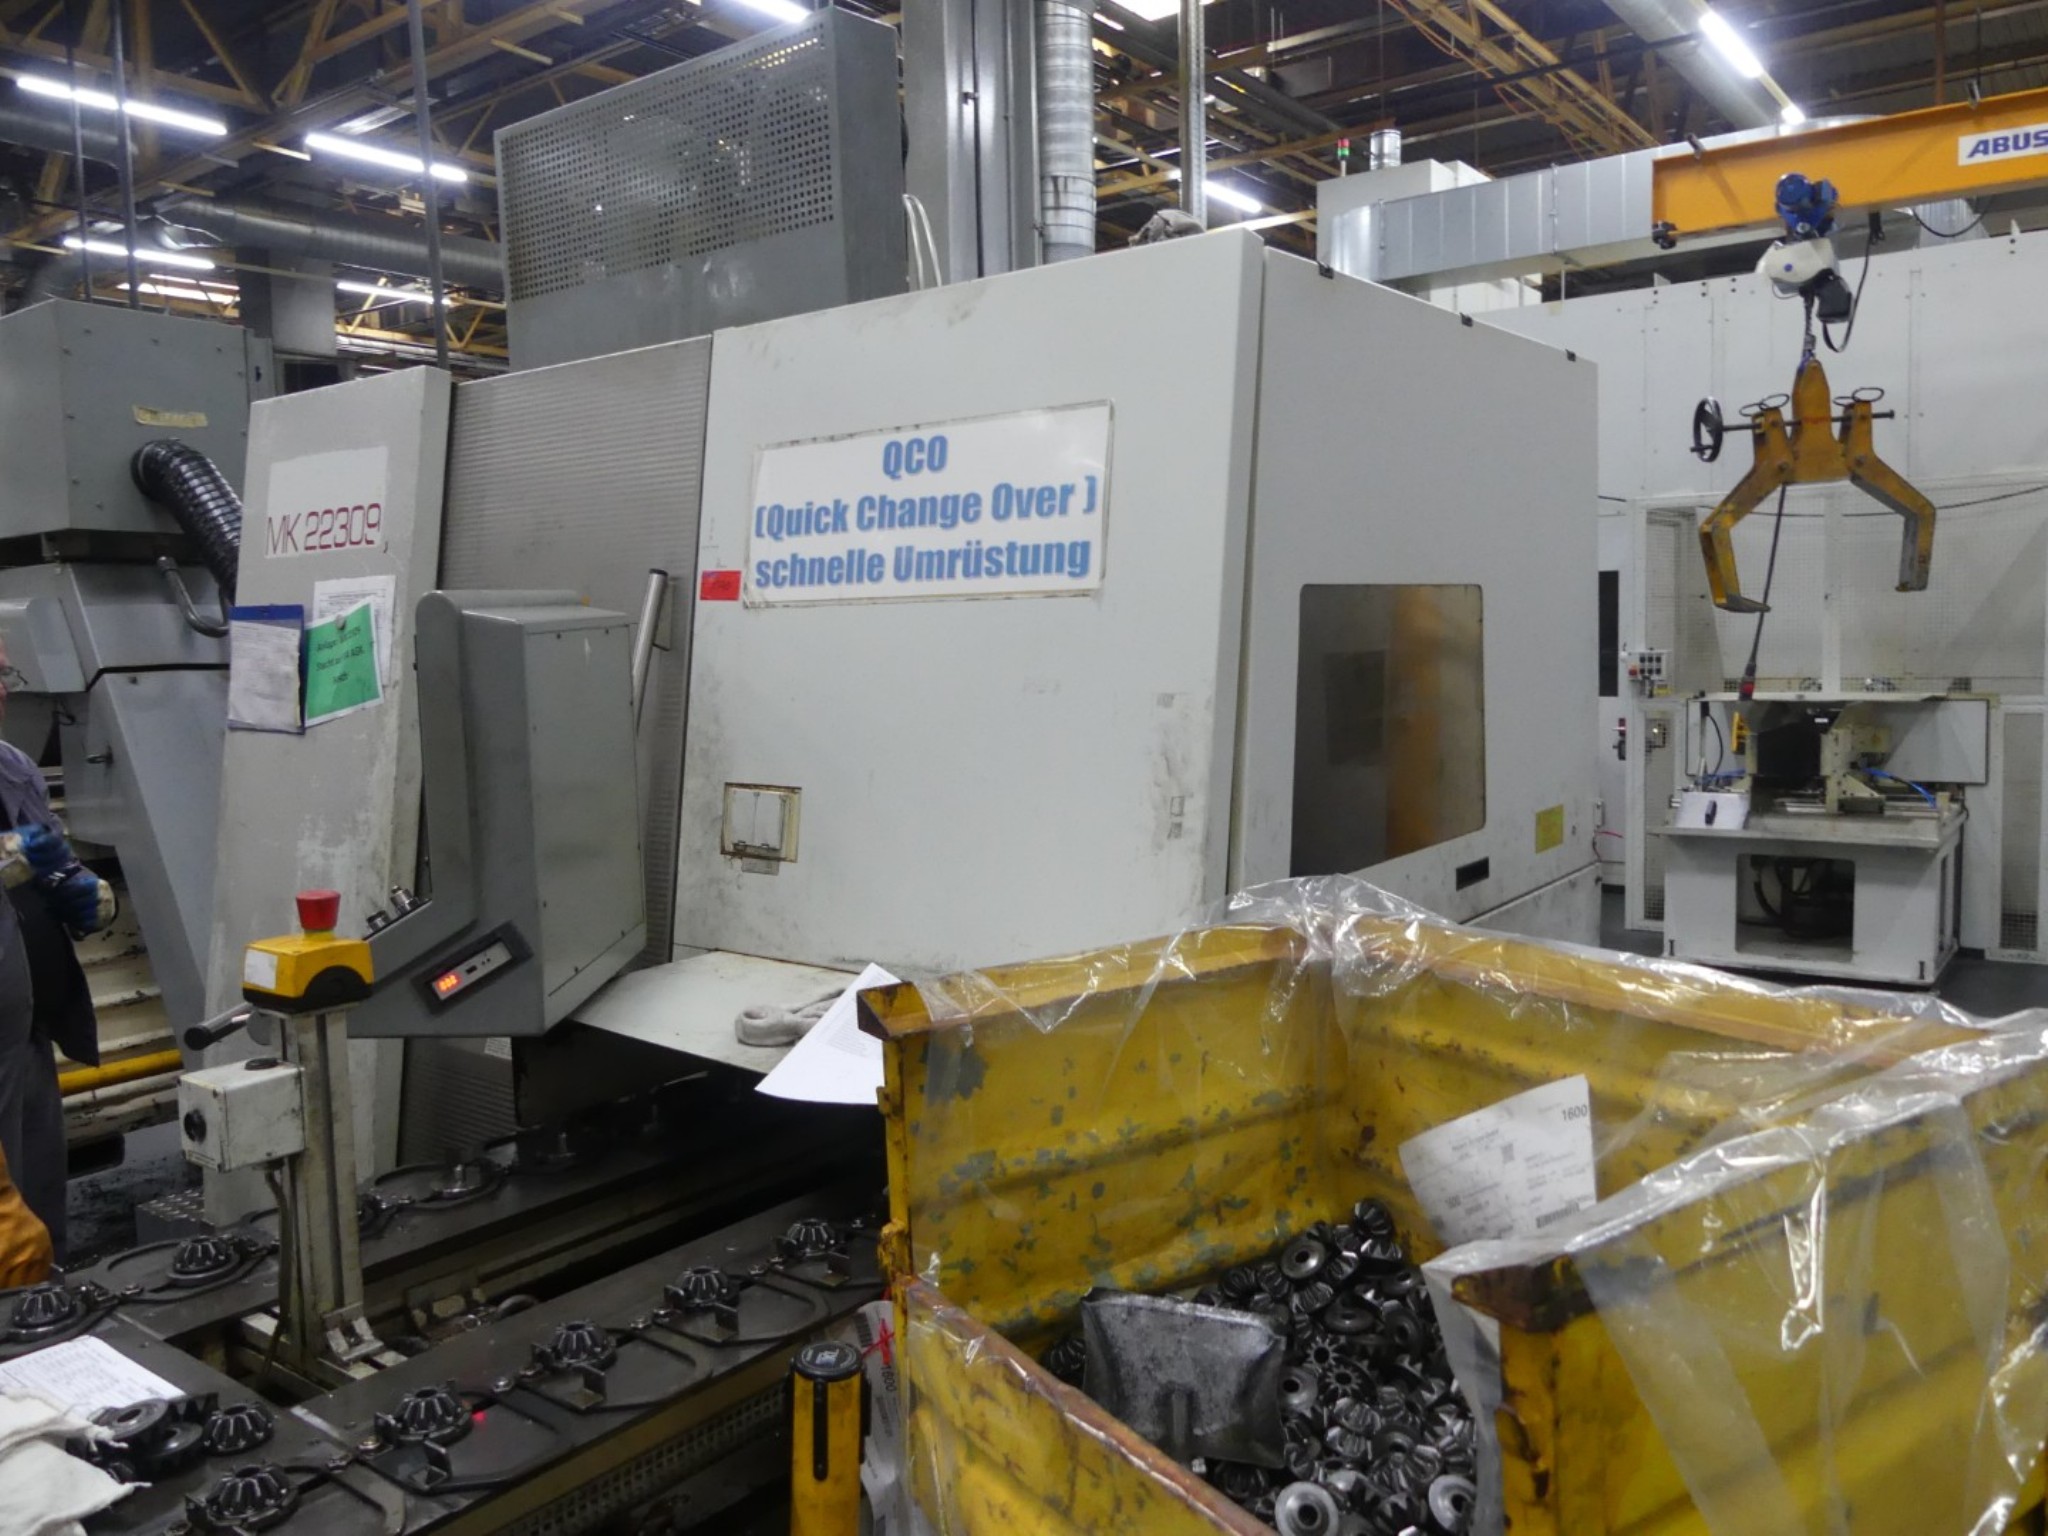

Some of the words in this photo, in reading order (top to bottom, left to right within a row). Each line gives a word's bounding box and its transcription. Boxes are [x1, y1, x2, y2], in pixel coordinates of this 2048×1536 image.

[1966, 130, 2048, 159] ABUS
[883, 435, 948, 480] QCO
[265, 513, 302, 556] MK
[304, 503, 381, 551] 22309
[857, 495, 982, 530] Change
[992, 483, 1075, 521] Over
[755, 553, 885, 588] schnelle
[894, 540, 1091, 580] Umrüstung
[1562, 1104, 1588, 1121] 1600
